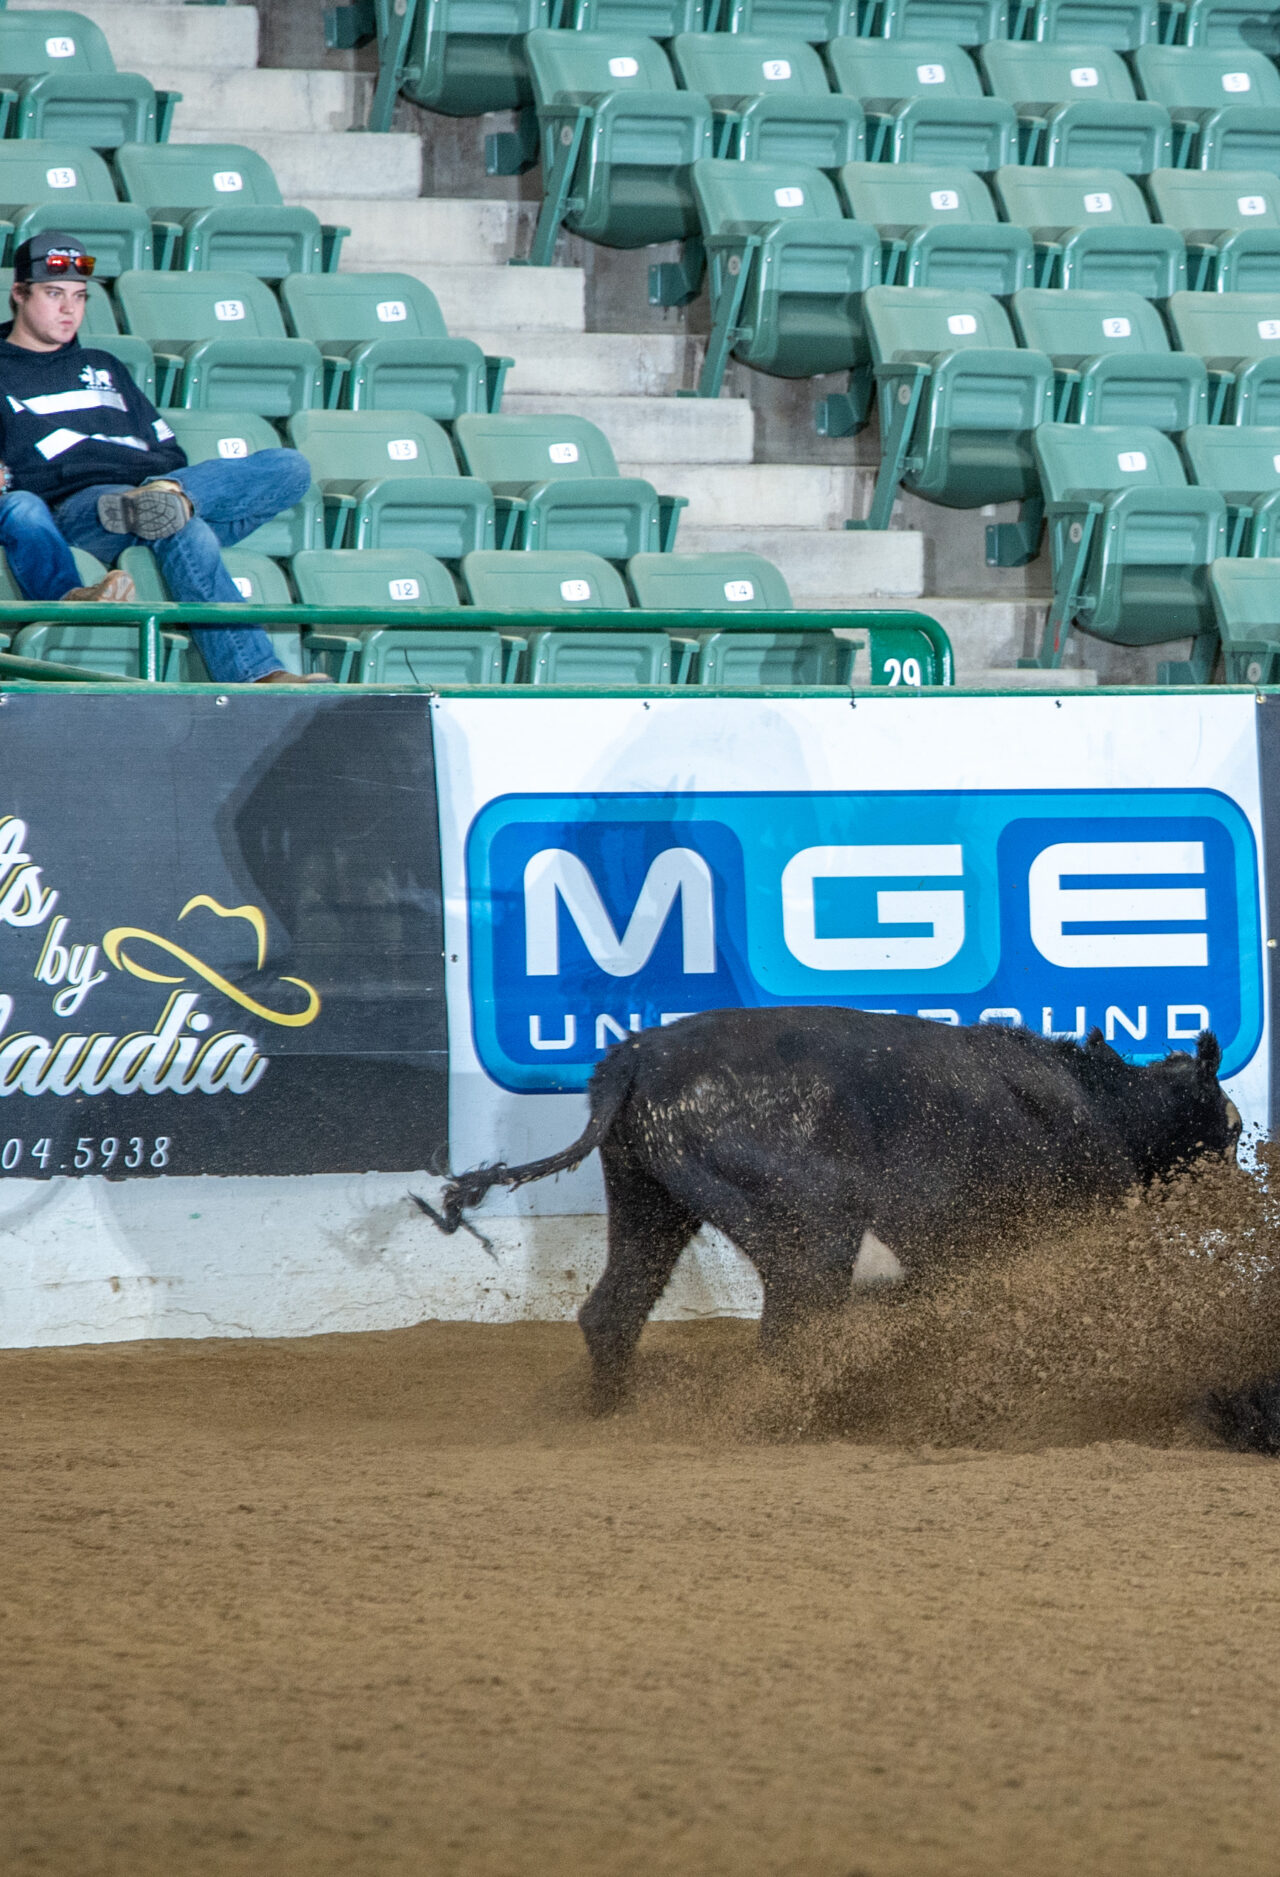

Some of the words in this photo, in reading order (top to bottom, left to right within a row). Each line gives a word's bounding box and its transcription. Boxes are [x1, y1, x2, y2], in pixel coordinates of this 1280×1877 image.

[883, 658, 922, 687] 29
[523, 841, 1209, 978] MGE
[34, 914, 109, 1018] by
